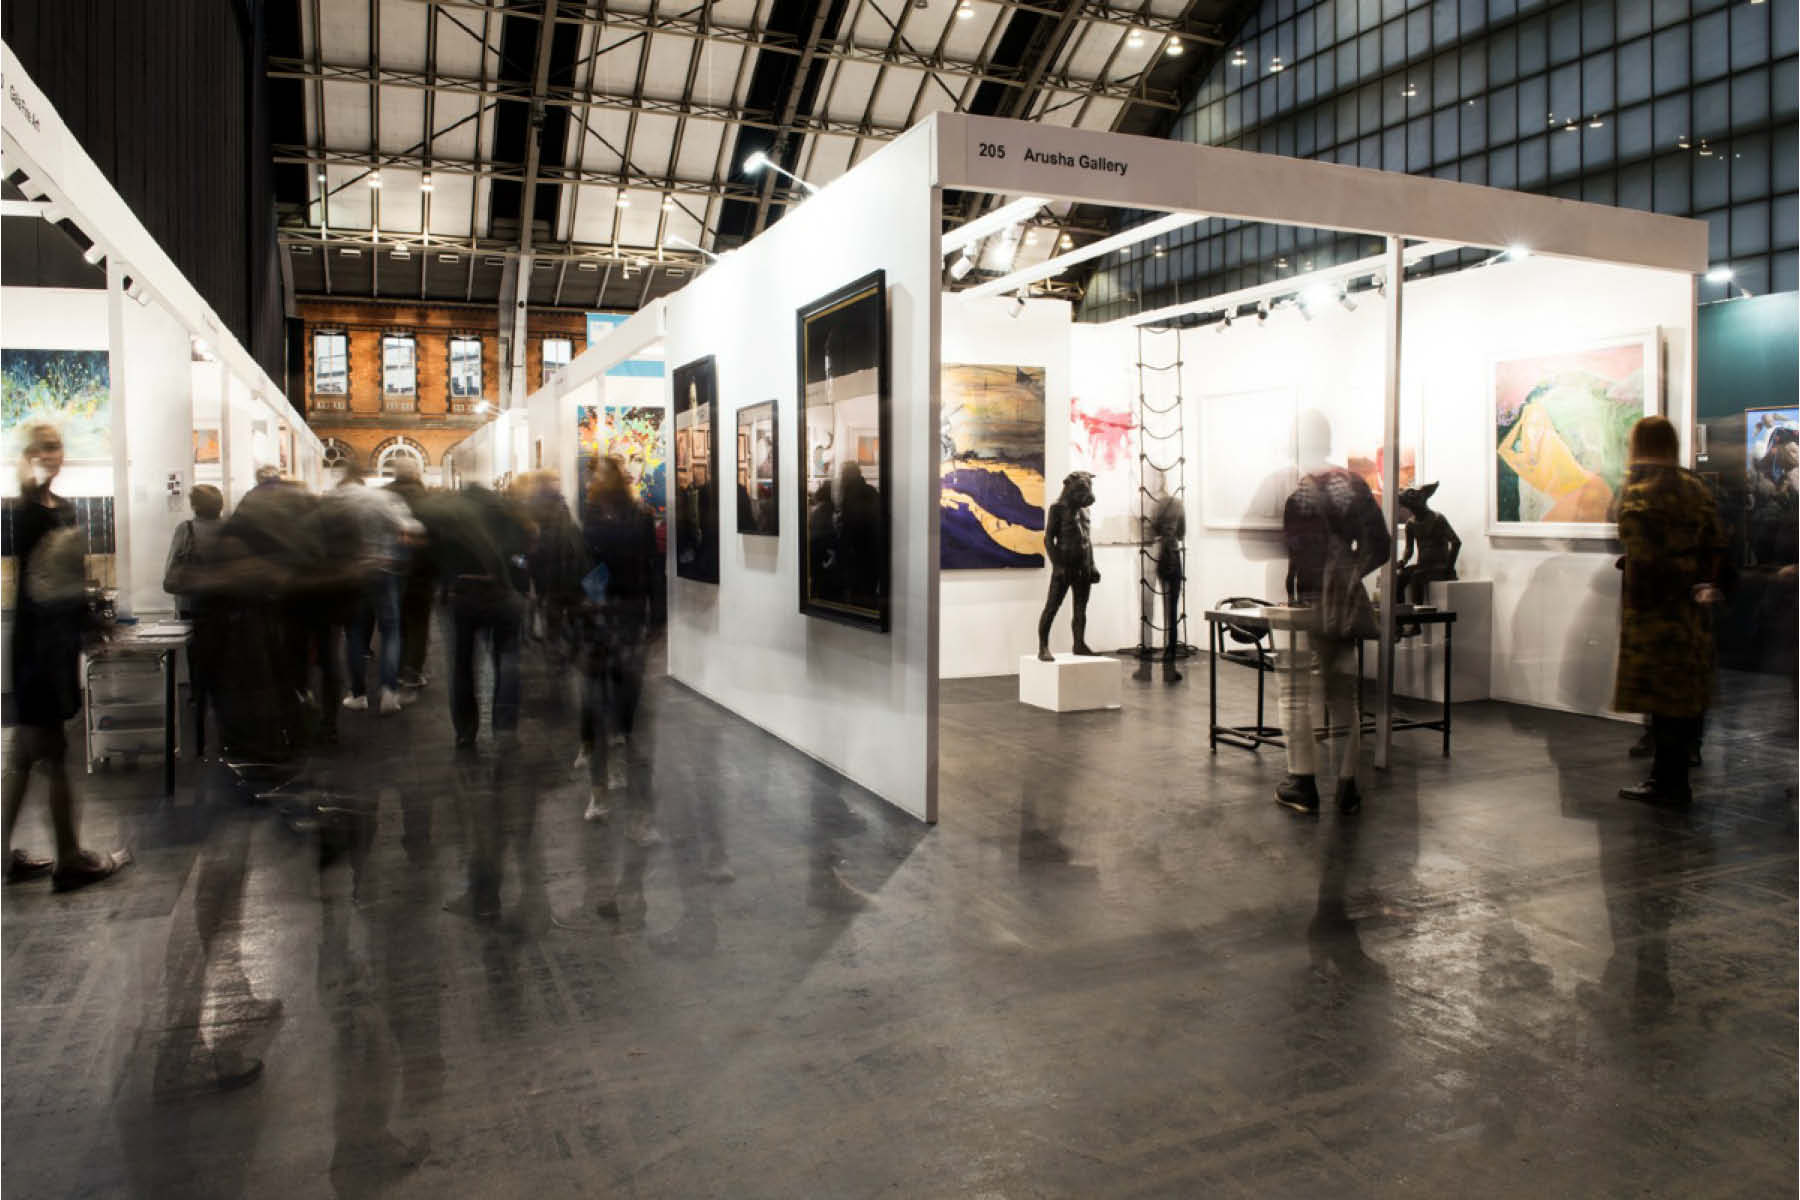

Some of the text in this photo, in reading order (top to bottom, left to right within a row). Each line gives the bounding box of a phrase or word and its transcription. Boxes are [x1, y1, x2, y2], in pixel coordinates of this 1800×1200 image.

[979, 143, 1129, 176] 205 Arusha Gallery
